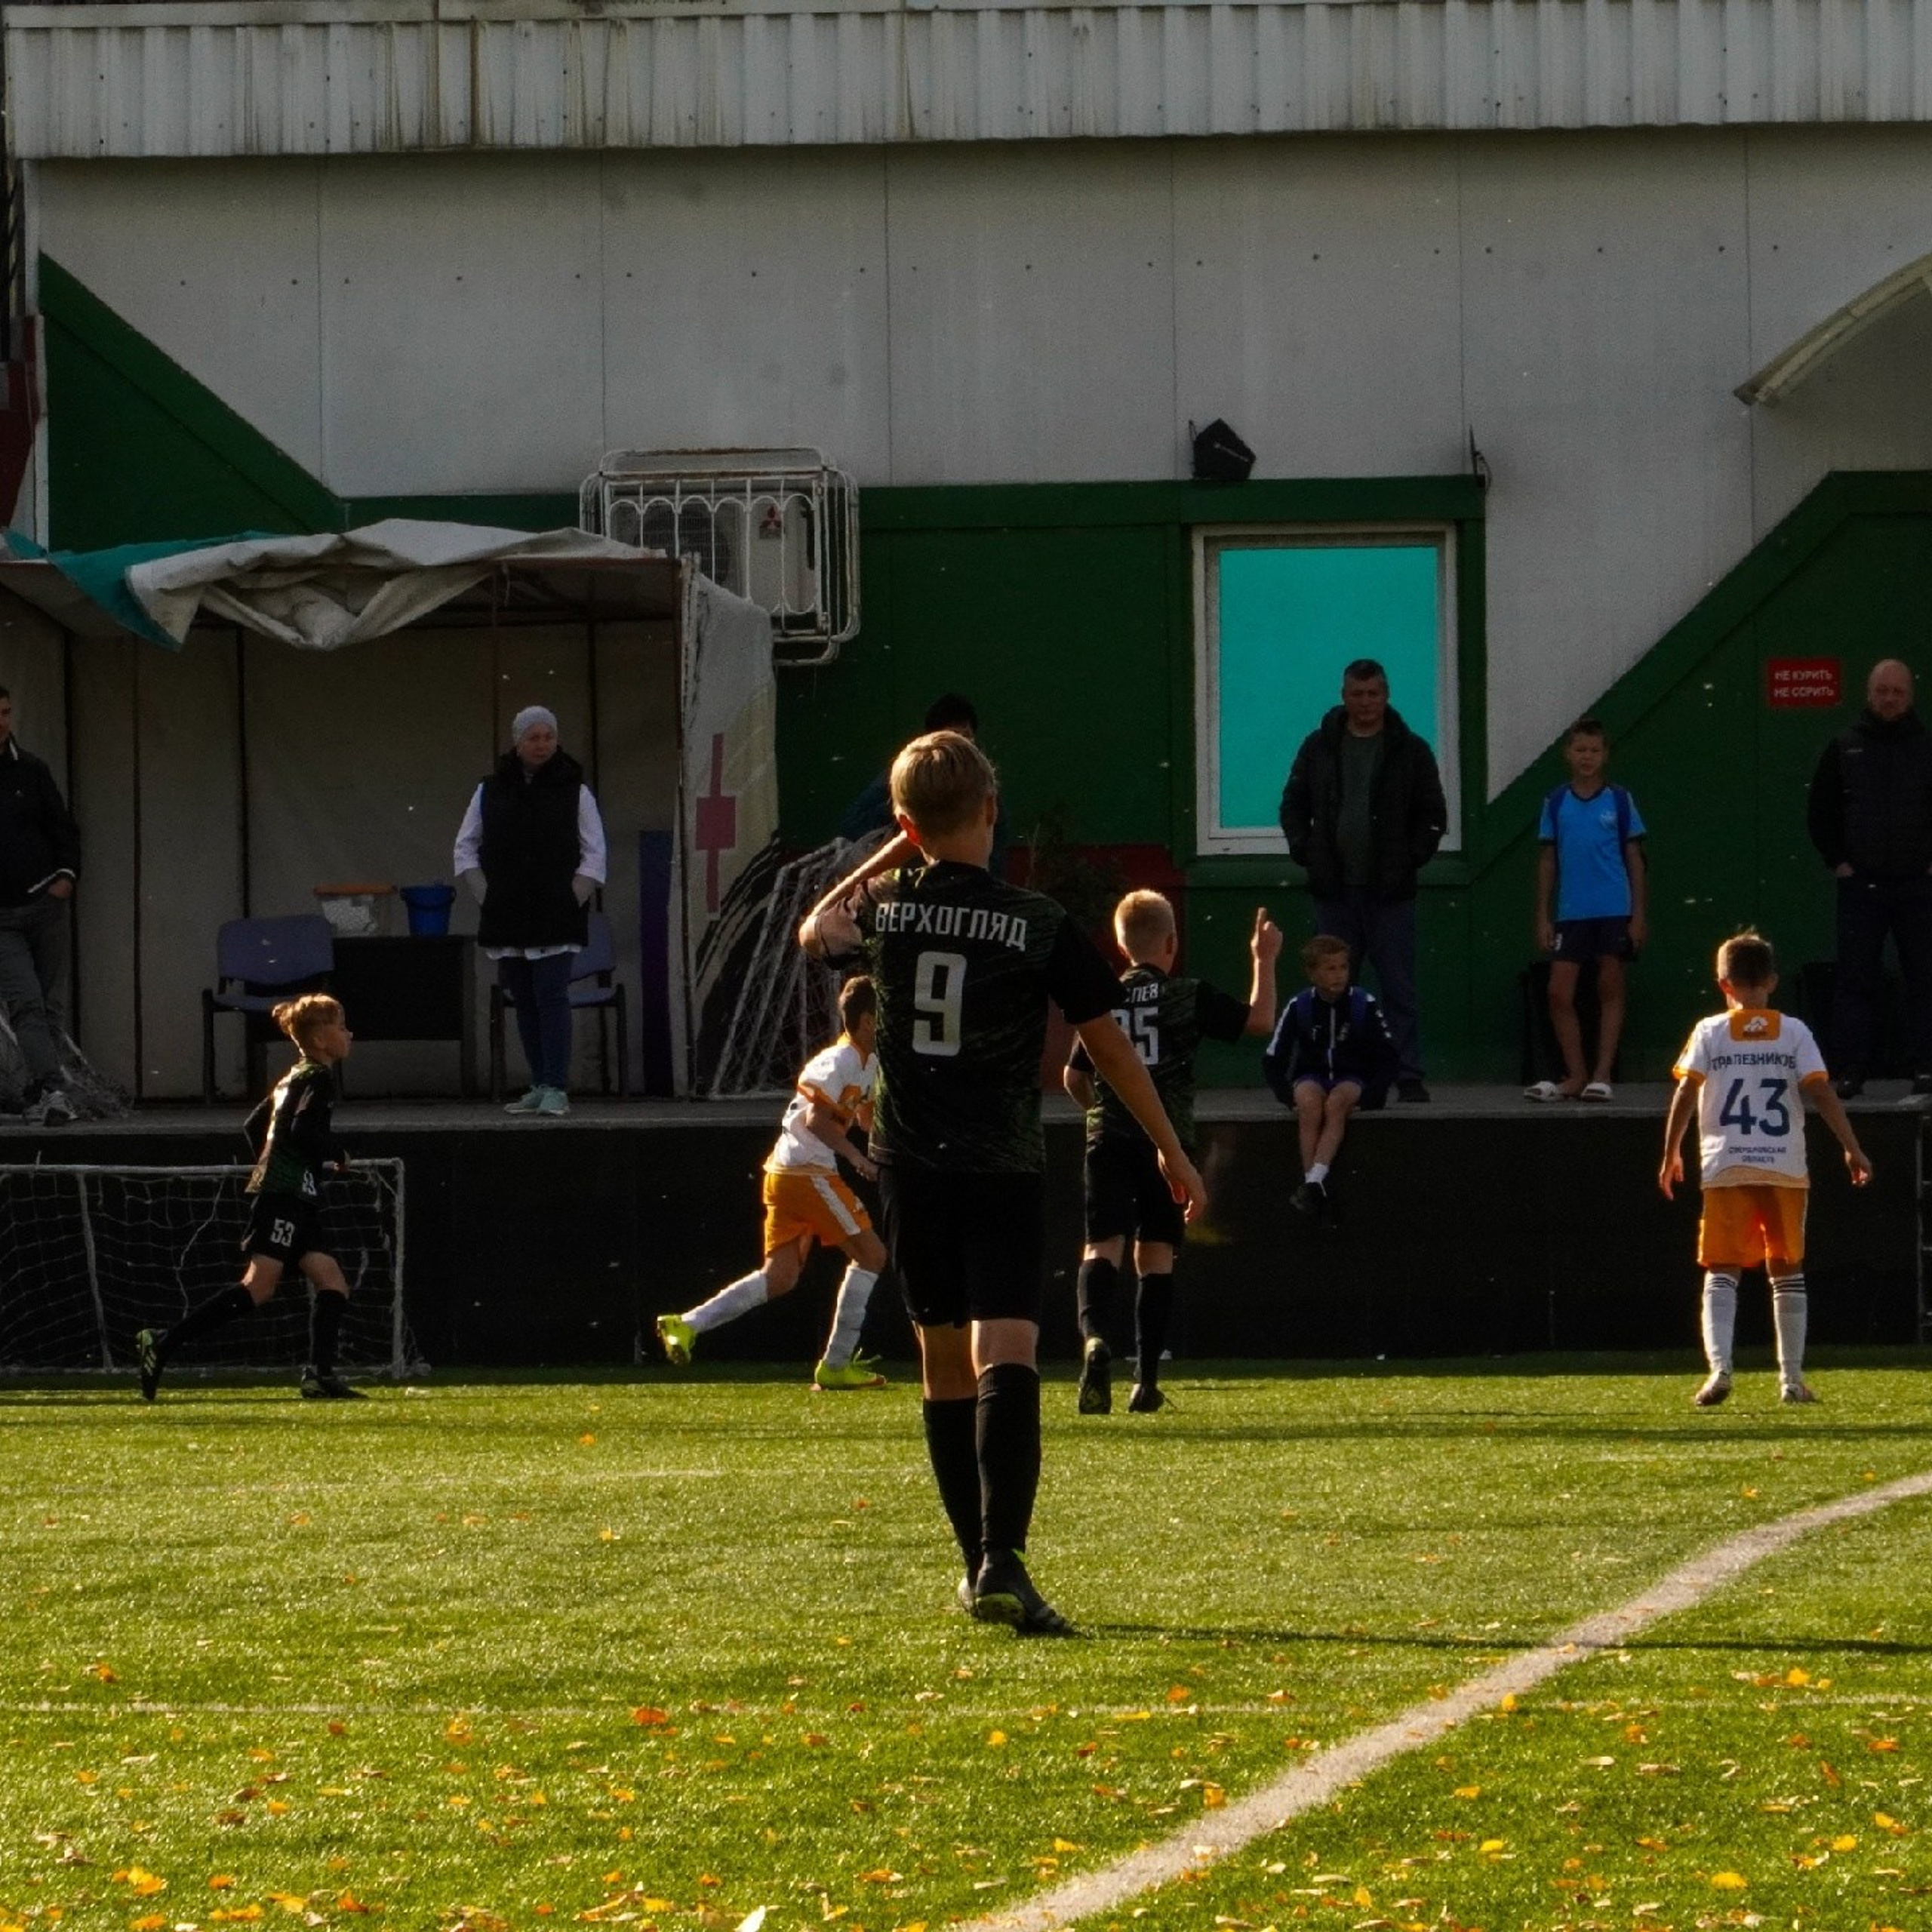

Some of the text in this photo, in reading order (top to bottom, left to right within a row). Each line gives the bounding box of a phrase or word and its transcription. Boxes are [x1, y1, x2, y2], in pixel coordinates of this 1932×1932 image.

[1774, 670, 1790, 680] НЕ
[1774, 687, 1835, 697] НЕ СОРИТЬ
[875, 902, 1027, 952] ВЕРХОГЛЯД
[912, 951, 967, 1056] 9
[1720, 1078, 1790, 1137] 43
[270, 1217, 295, 1246] 53
